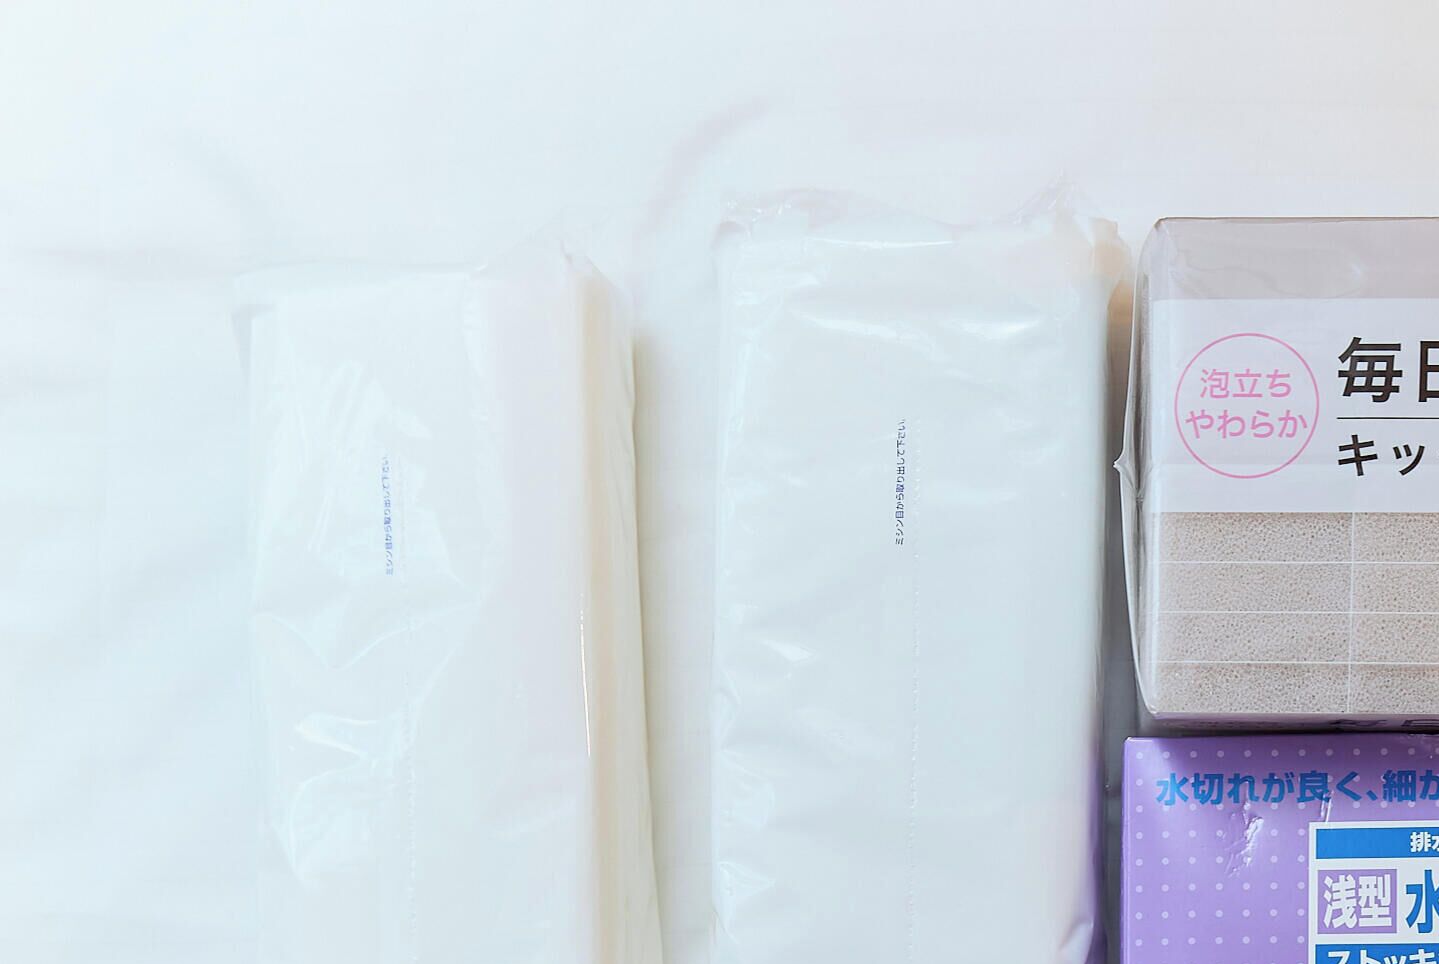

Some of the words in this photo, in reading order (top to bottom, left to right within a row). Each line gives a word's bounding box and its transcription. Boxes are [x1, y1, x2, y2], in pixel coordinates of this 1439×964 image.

[1200, 369, 1292, 398] 泡立ち
[1185, 409, 1308, 440] やわらか
[1324, 874, 1391, 929] 浅型
